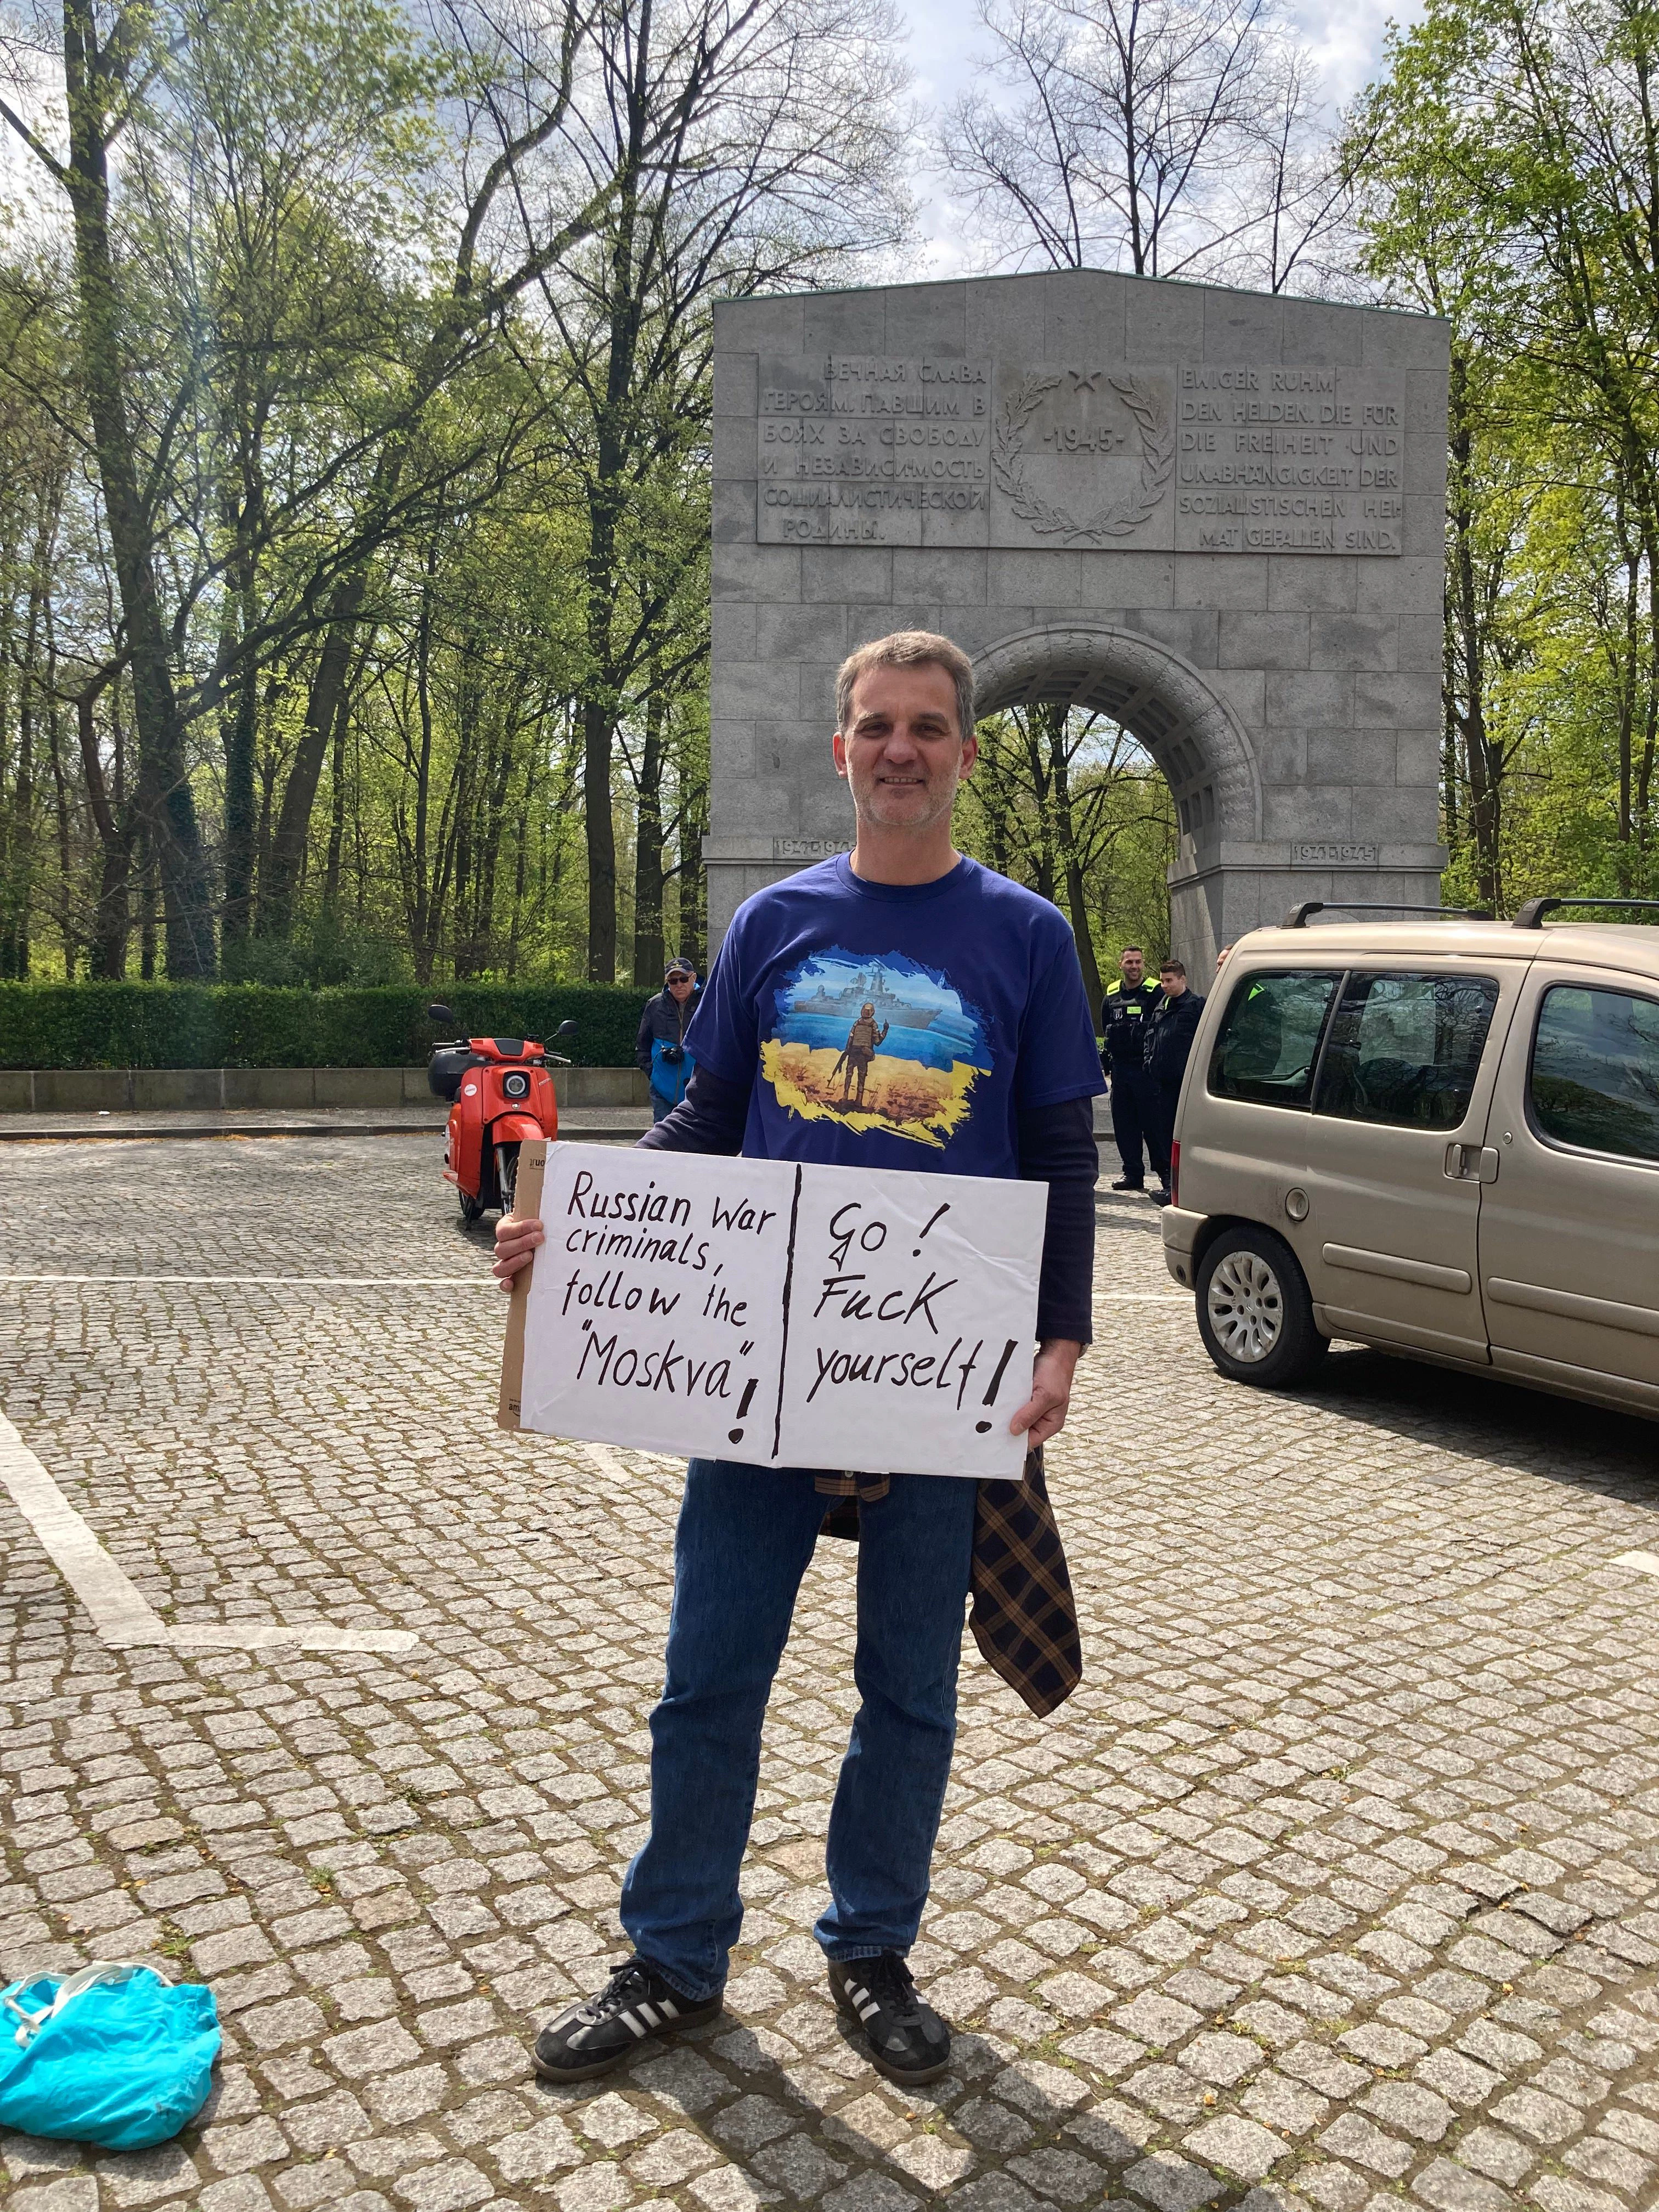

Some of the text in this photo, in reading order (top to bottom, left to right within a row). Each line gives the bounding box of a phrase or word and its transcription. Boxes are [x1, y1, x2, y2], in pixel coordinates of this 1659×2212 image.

[824, 363, 986, 383] ВЕЧНАЯ СЛАВА
[1182, 369, 1333, 392] EWIGER RUHM
[861, 393, 960, 415] ПАВШИМ
[974, 395, 985, 415] В
[1182, 399, 1222, 421] DEN
[1321, 403, 1352, 424] DIE
[764, 422, 986, 447] БОЯХ ЗА СВОБОДУ
[1181, 431, 1397, 455] DIE FREIHEIT UND
[764, 455, 985, 478] И НЕЗАВИСИМОСТЬ
[1361, 466, 1398, 487] DER
[764, 487, 985, 510] СОЦИАЛИСТИЧЕСКОЙ
[1180, 495, 1345, 517] SOZIALISTISCHEN
[1199, 527, 1238, 546] MAT
[1246, 527, 1335, 548] GEFALLEN
[568, 1171, 691, 1226] Russian
[566, 1225, 723, 1276] criminals,
[562, 1269, 747, 1327] follow the
